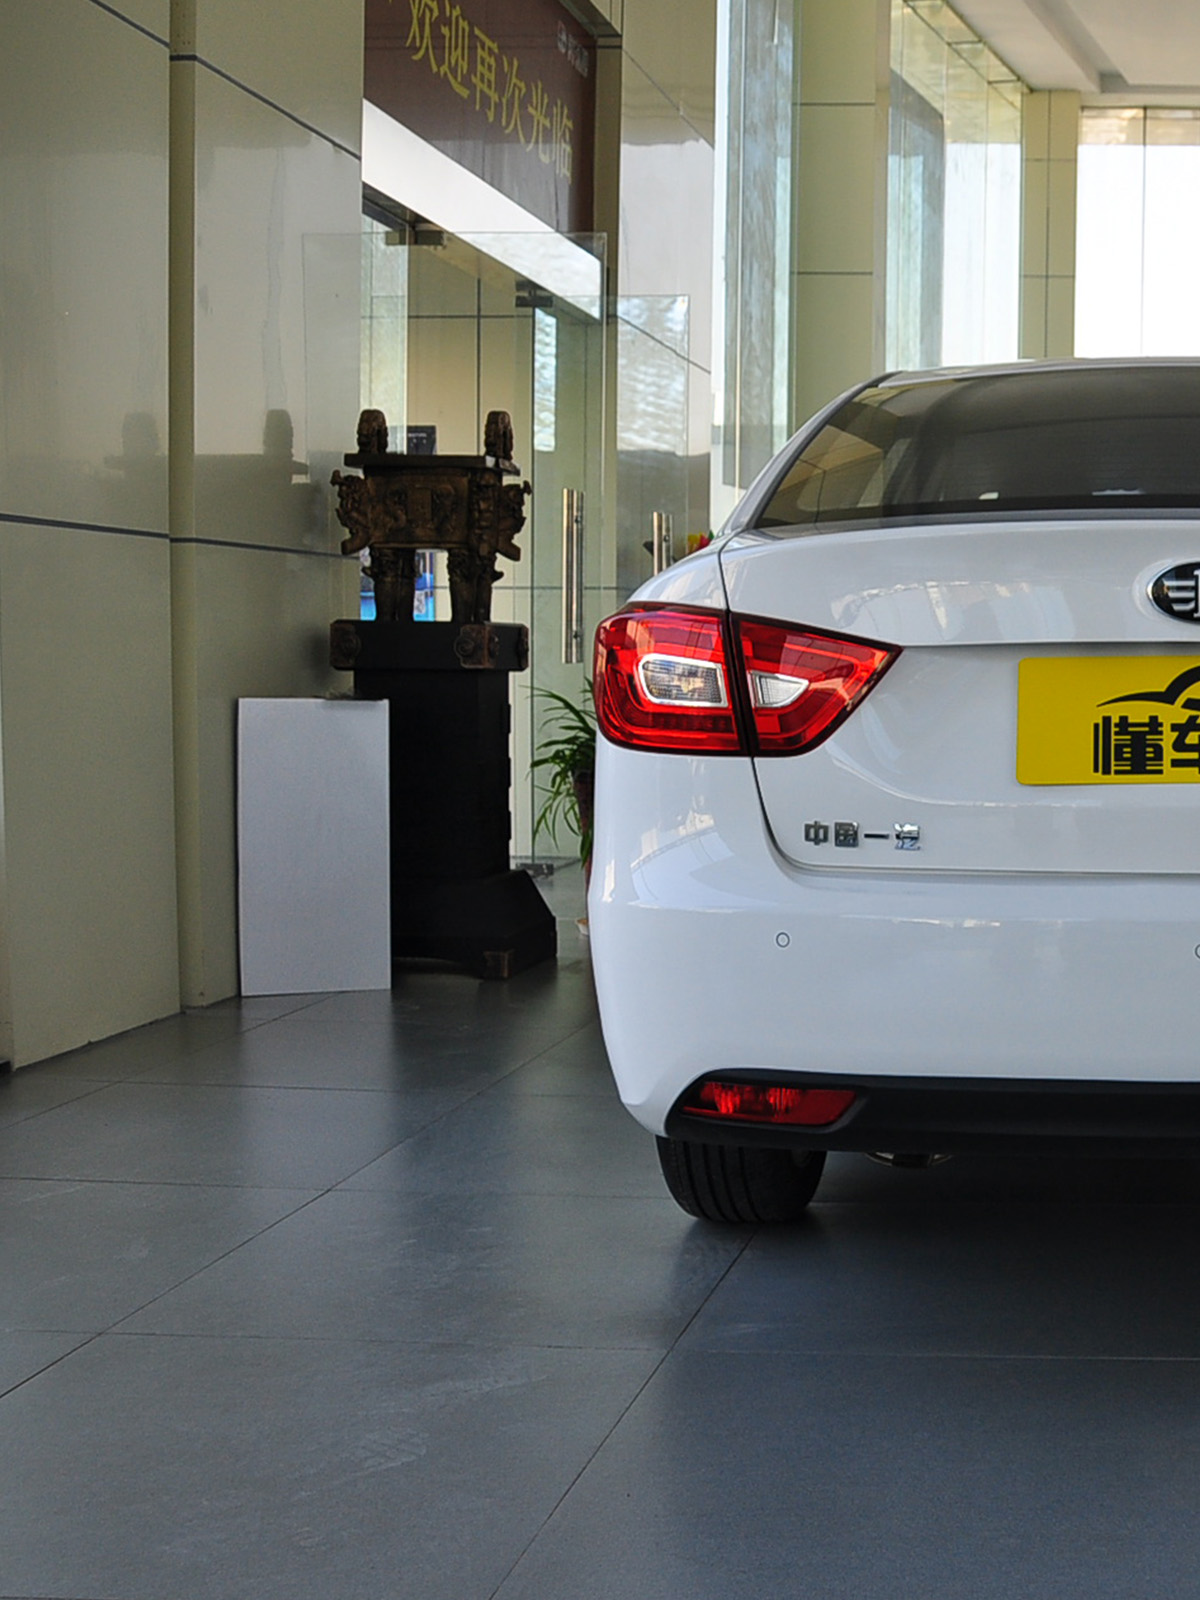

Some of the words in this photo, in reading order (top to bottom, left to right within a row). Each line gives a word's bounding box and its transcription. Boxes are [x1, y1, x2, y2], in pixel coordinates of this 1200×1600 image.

[406, 0, 574, 184] 欢迎再次光临
[804, 820, 921, 851] 中国一汽
